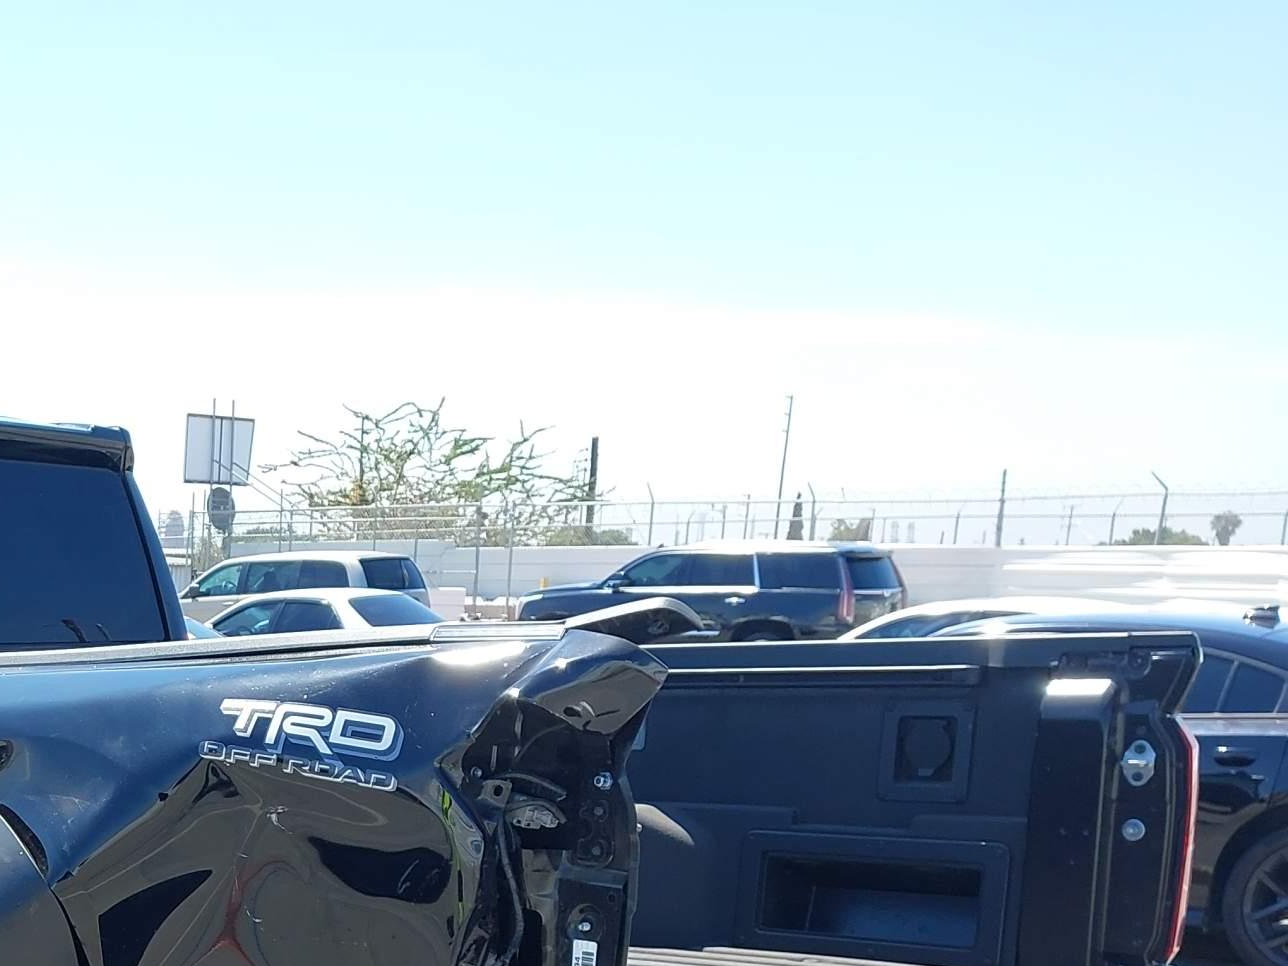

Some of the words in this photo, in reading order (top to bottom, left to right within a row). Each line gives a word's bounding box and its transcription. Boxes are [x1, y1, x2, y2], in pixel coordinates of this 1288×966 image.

[220, 698, 404, 761] TRD
[199, 741, 278, 767] OFF
[282, 756, 398, 792] ROAD
